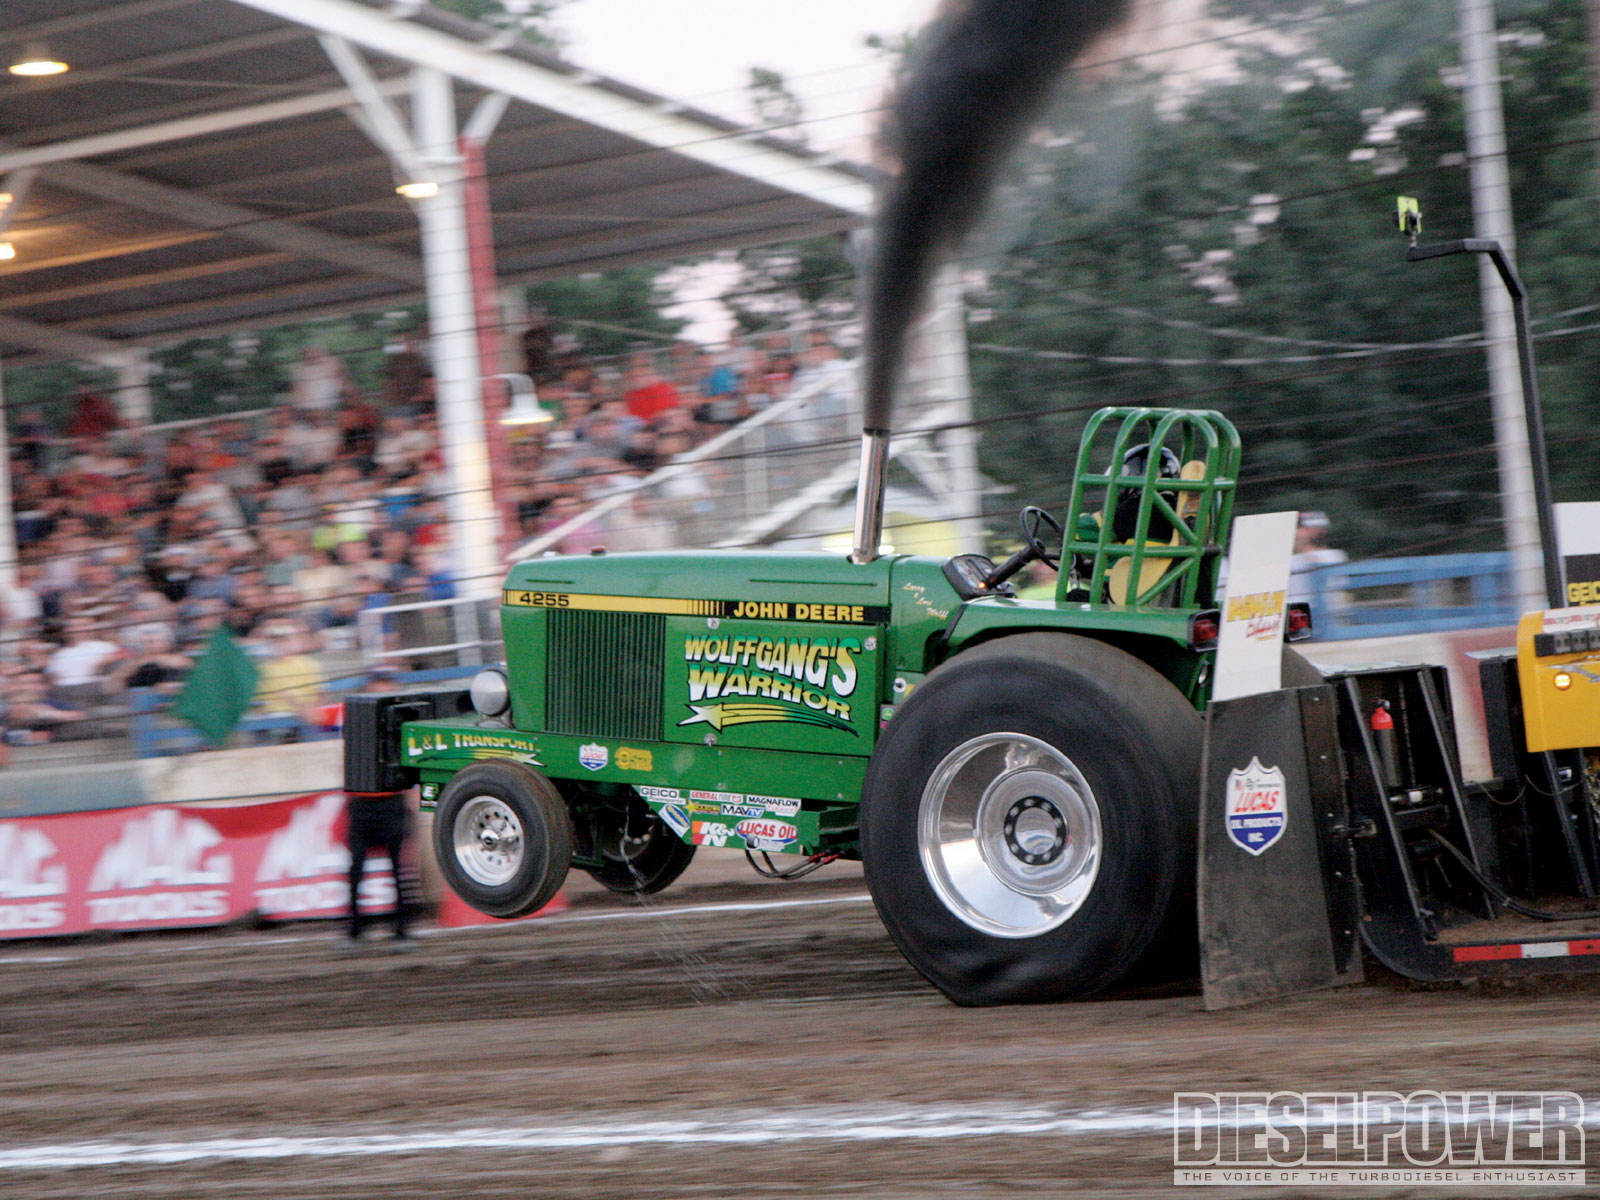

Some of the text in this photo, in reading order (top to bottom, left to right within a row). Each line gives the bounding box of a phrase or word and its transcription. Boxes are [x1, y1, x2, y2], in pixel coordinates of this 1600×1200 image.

[519, 591, 570, 608] 4255
[733, 600, 865, 623] JOHN DEERE
[684, 633, 862, 698] WOLFFGANG'S
[686, 663, 853, 722] WARRIOR
[452, 730, 539, 752] TRANSPORT
[641, 787, 678, 799] GEICO
[691, 791, 718, 801] GENERAL
[748, 796, 800, 808] MAGNAFLOW
[740, 821, 798, 840] LUCAS OIL
